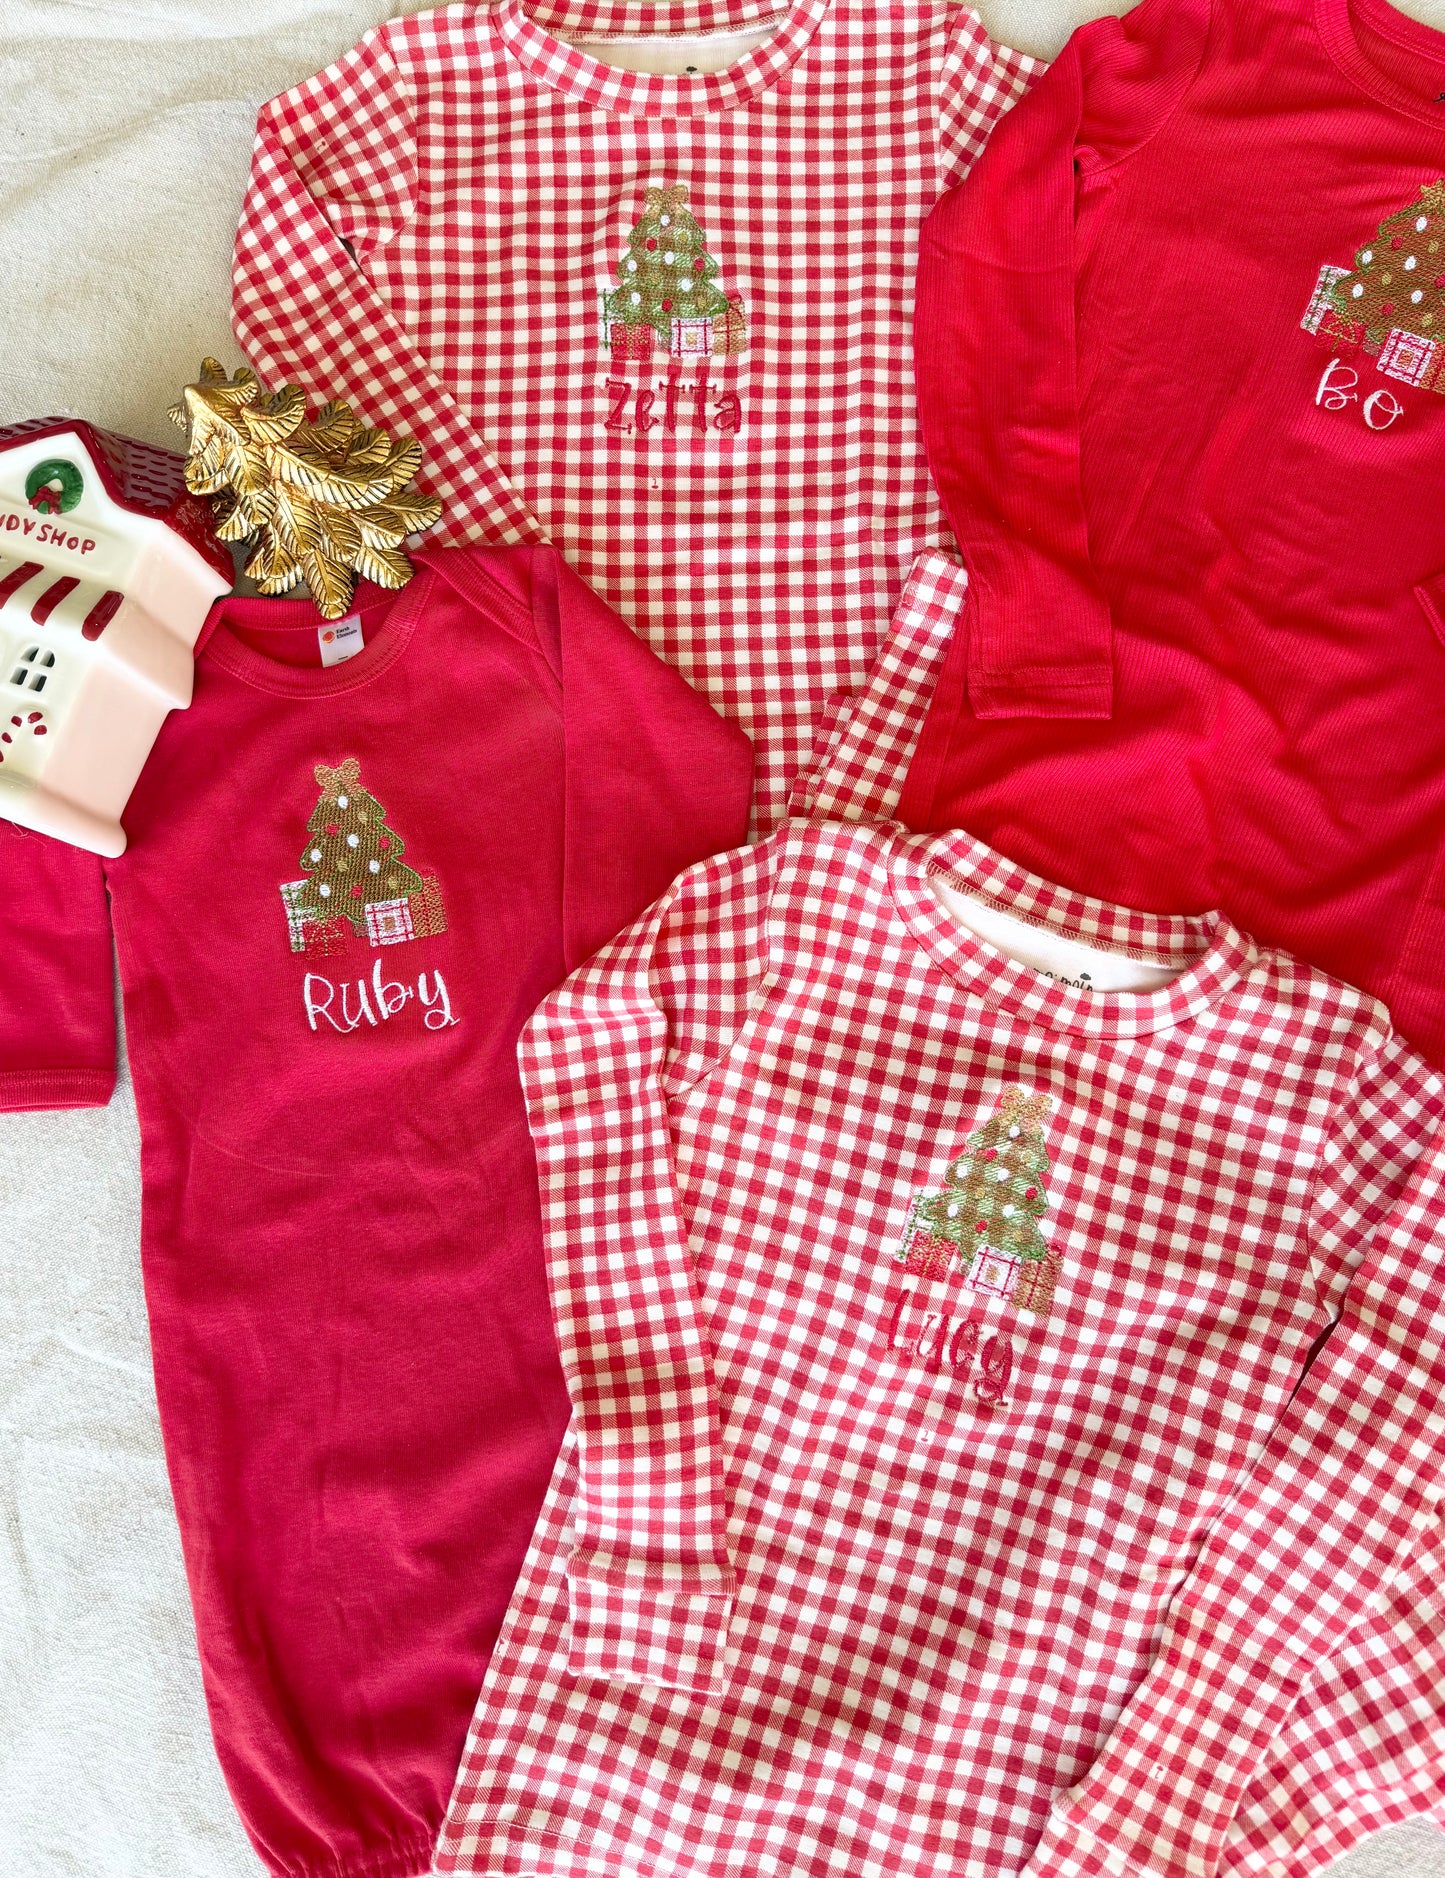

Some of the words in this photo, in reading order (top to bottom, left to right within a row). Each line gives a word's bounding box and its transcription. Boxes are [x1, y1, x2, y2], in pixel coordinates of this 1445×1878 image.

[604, 372, 742, 435] Zetta
[36, 523, 96, 555] SHOP
[304, 958, 460, 1033] Ruby
[887, 1289, 1013, 1407] Lucy
